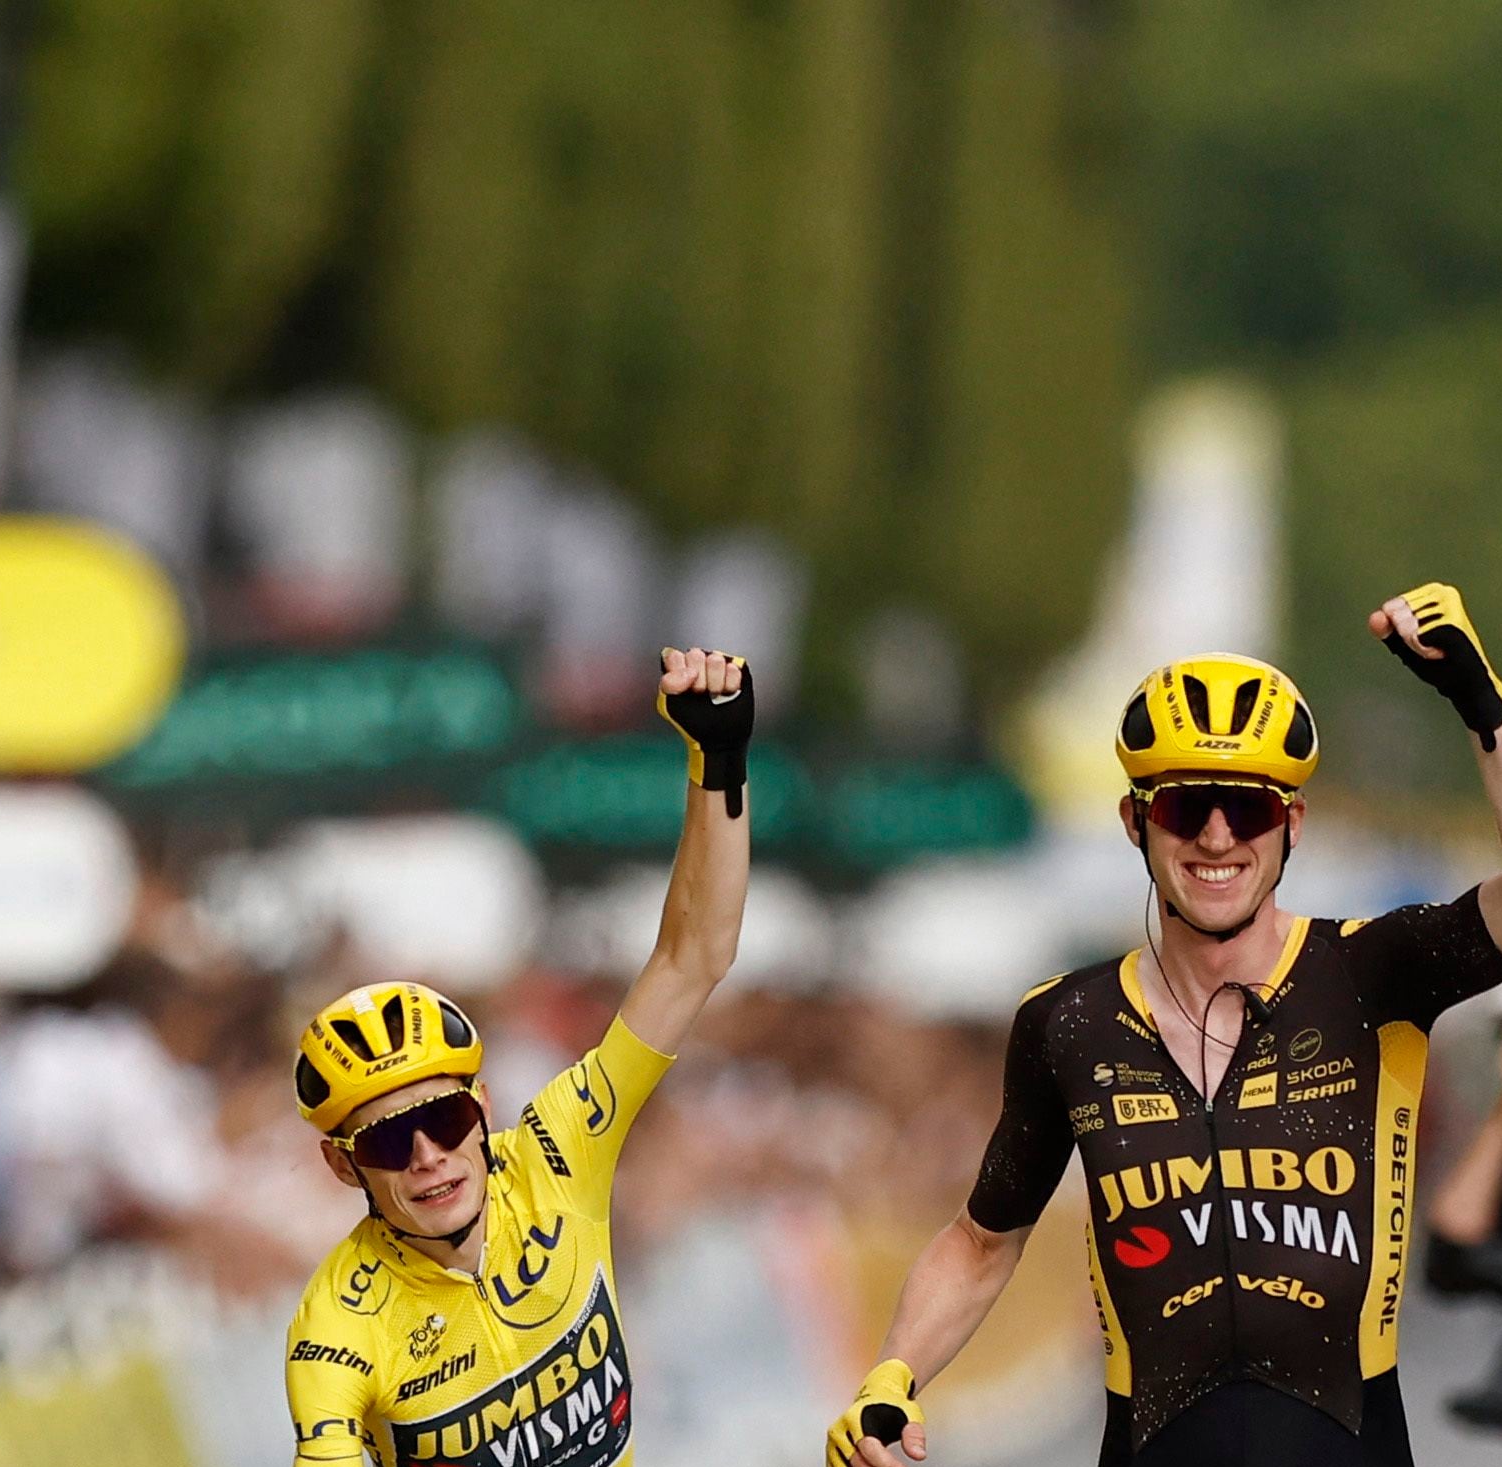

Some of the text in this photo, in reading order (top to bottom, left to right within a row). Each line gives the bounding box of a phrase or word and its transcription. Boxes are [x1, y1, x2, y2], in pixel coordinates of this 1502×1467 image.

[1252, 700, 1275, 741] JUMBO
[1193, 739, 1242, 751] LAZER
[412, 1007, 423, 1046] JUMBO
[330, 1048, 354, 1073] VISMA
[364, 1054, 409, 1078] LAZER
[1247, 1053, 1278, 1072] AGU
[1137, 1098, 1162, 1108] BET
[1243, 1084, 1274, 1098] HEMA
[1286, 1077, 1357, 1103] SRAM
[1139, 1107, 1170, 1117] CITY
[1098, 1145, 1357, 1223] JUMBO
[1180, 1199, 1361, 1265] VISMA
[492, 1215, 564, 1308] LCL
[340, 1259, 382, 1308] LCL
[408, 1312, 609, 1461] JUMBO
[586, 1419, 608, 1447] G
